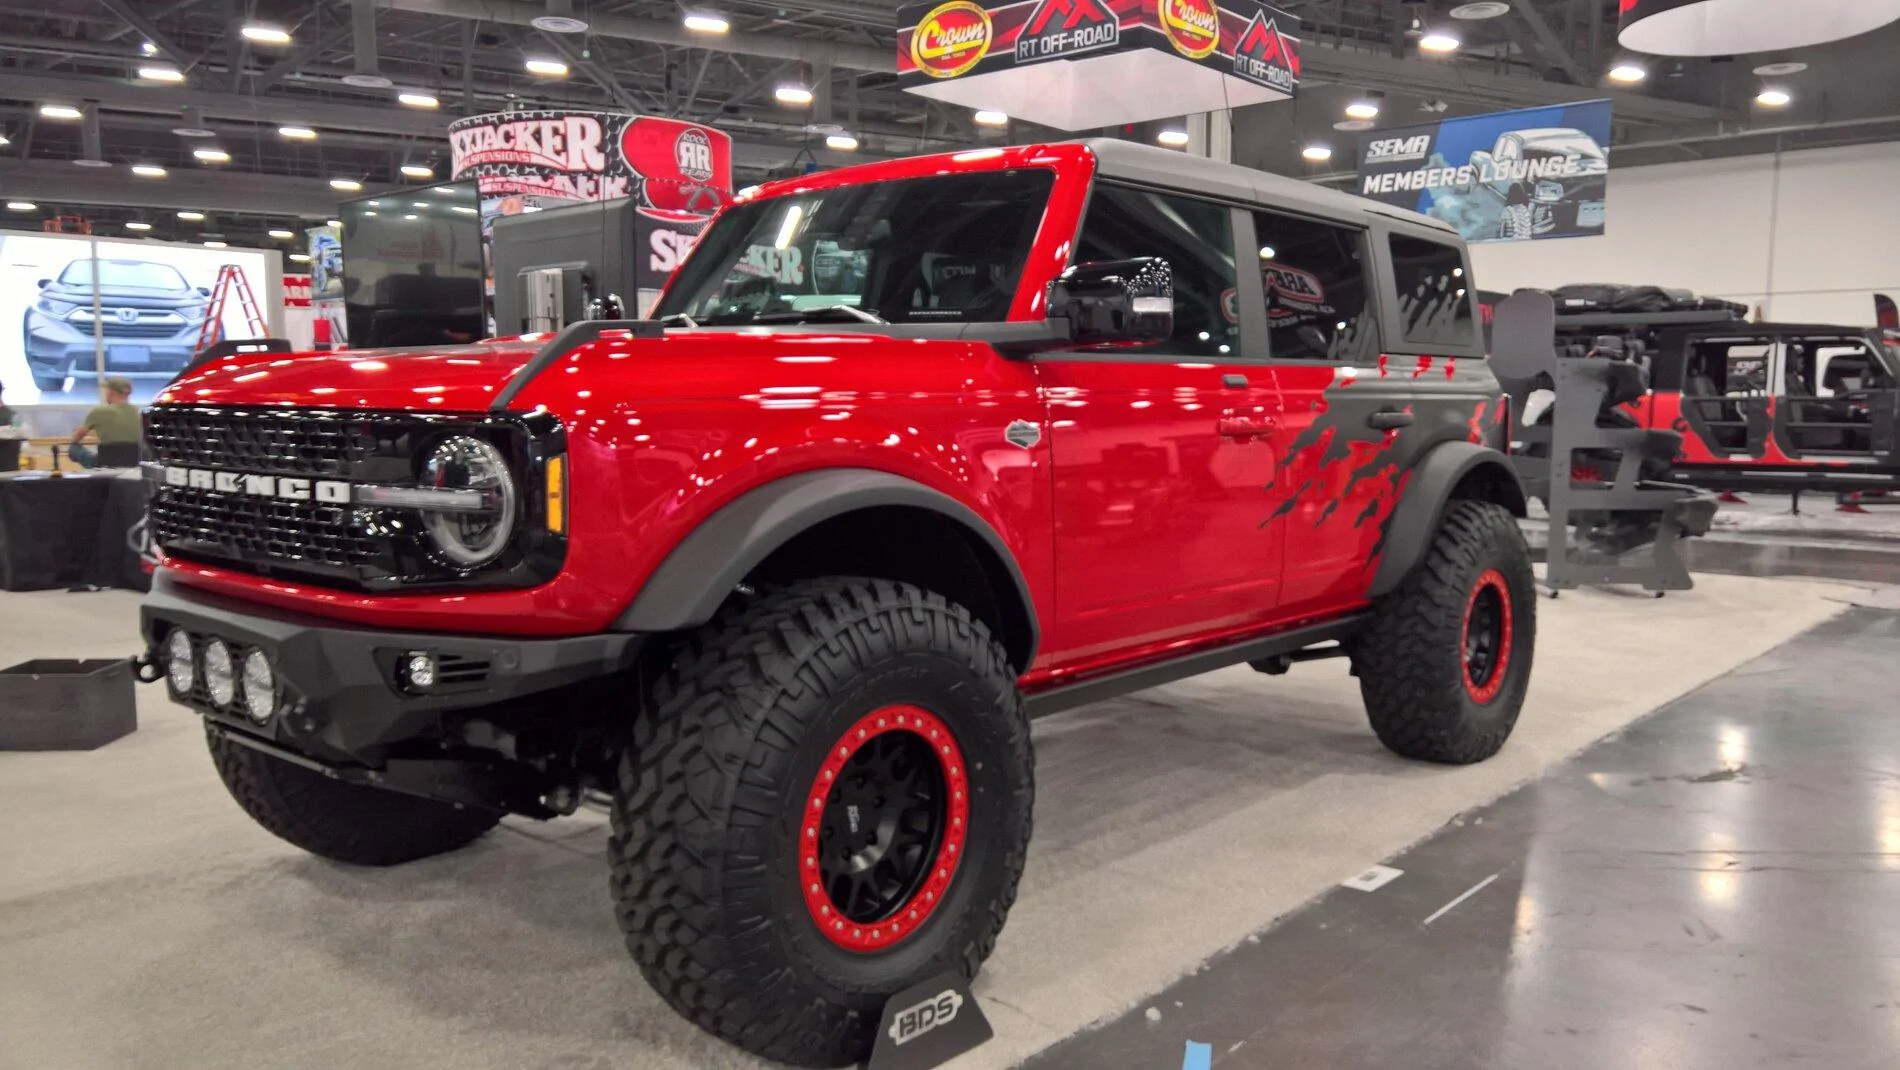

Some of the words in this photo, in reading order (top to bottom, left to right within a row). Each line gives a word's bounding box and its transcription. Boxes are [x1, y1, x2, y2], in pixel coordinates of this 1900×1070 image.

[919, 18, 986, 59] Crown
[1019, 38, 1038, 58] RT
[1040, 23, 1114, 55] OFF-ROAD
[1236, 53, 1249, 72] RT
[1249, 59, 1291, 87] OFF-ROAD
[1366, 135, 1431, 158] SEMA
[1363, 166, 1473, 194] MEMBERS
[1479, 154, 1581, 182] LOUNGE
[166, 466, 350, 504] BRONCO
